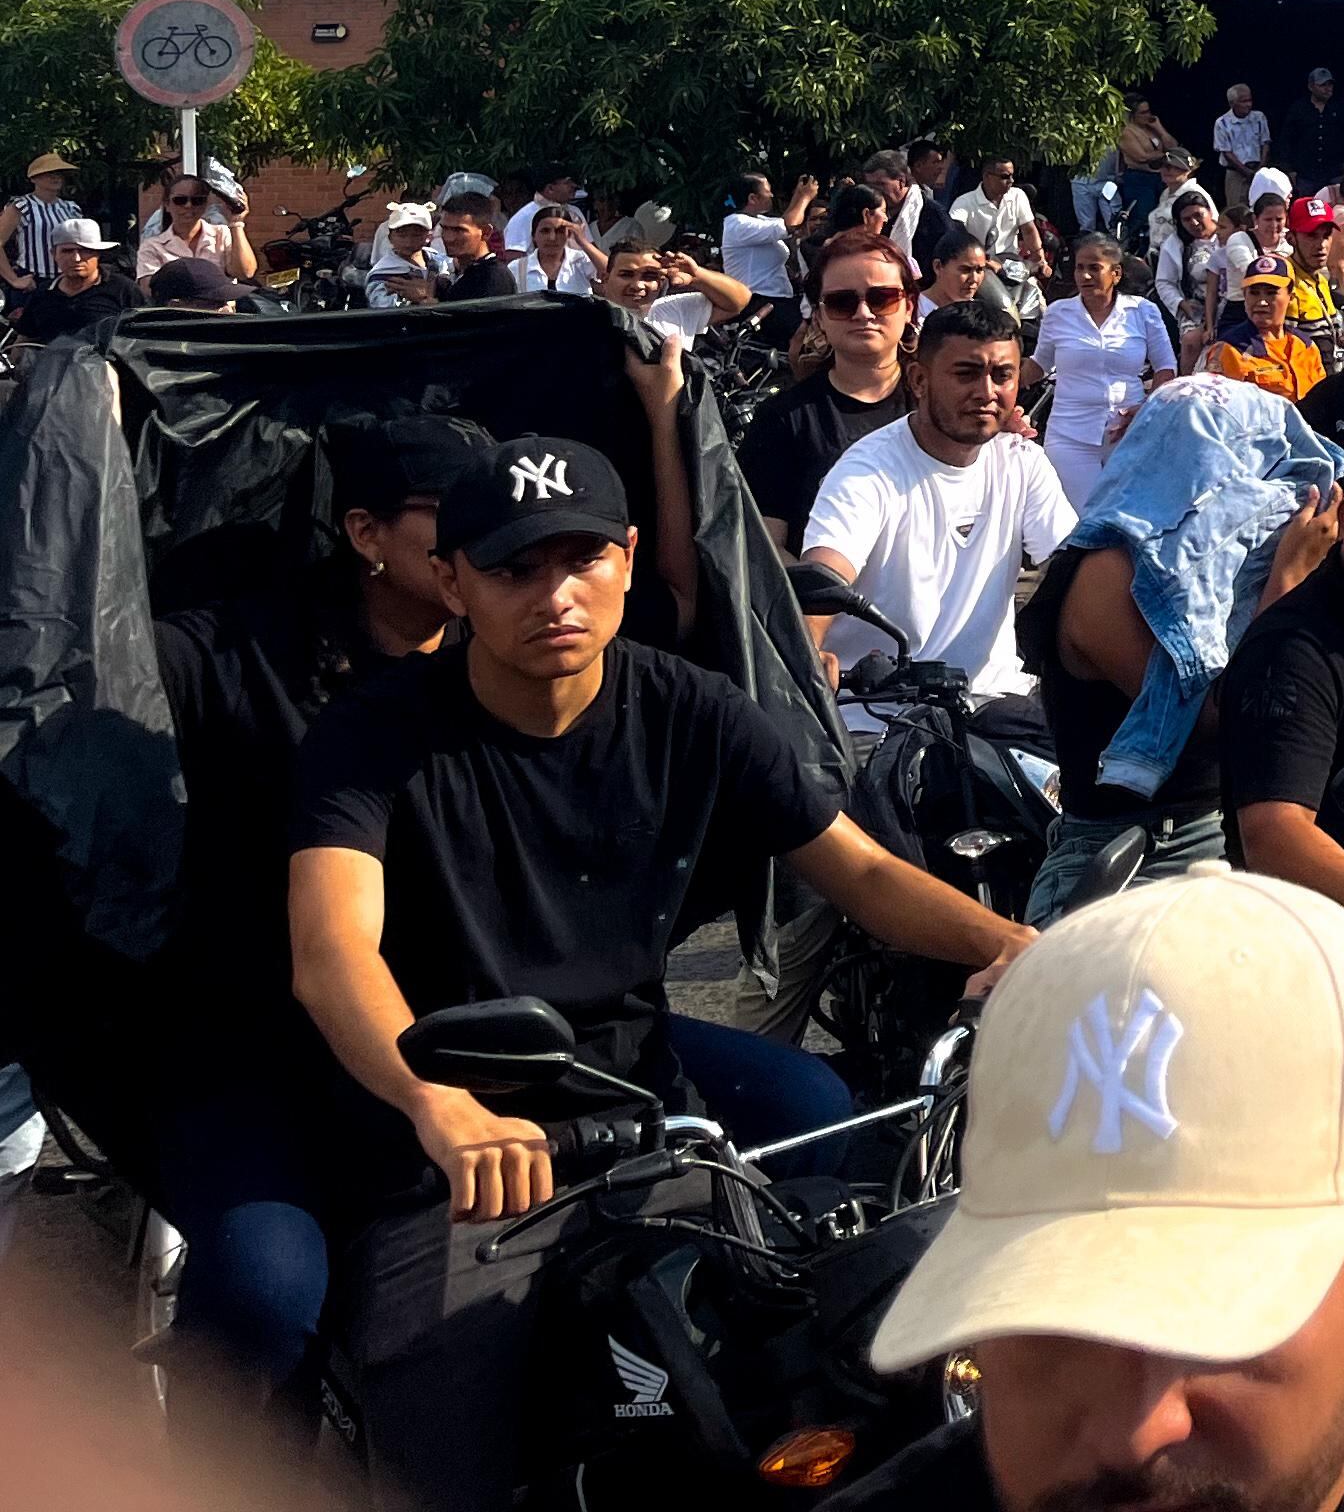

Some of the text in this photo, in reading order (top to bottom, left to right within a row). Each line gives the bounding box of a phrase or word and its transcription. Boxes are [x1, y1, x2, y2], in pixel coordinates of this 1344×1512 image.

[508, 452, 575, 502] NY
[1047, 987, 1185, 1155] NY
[613, 1401, 676, 1418] HONDA
